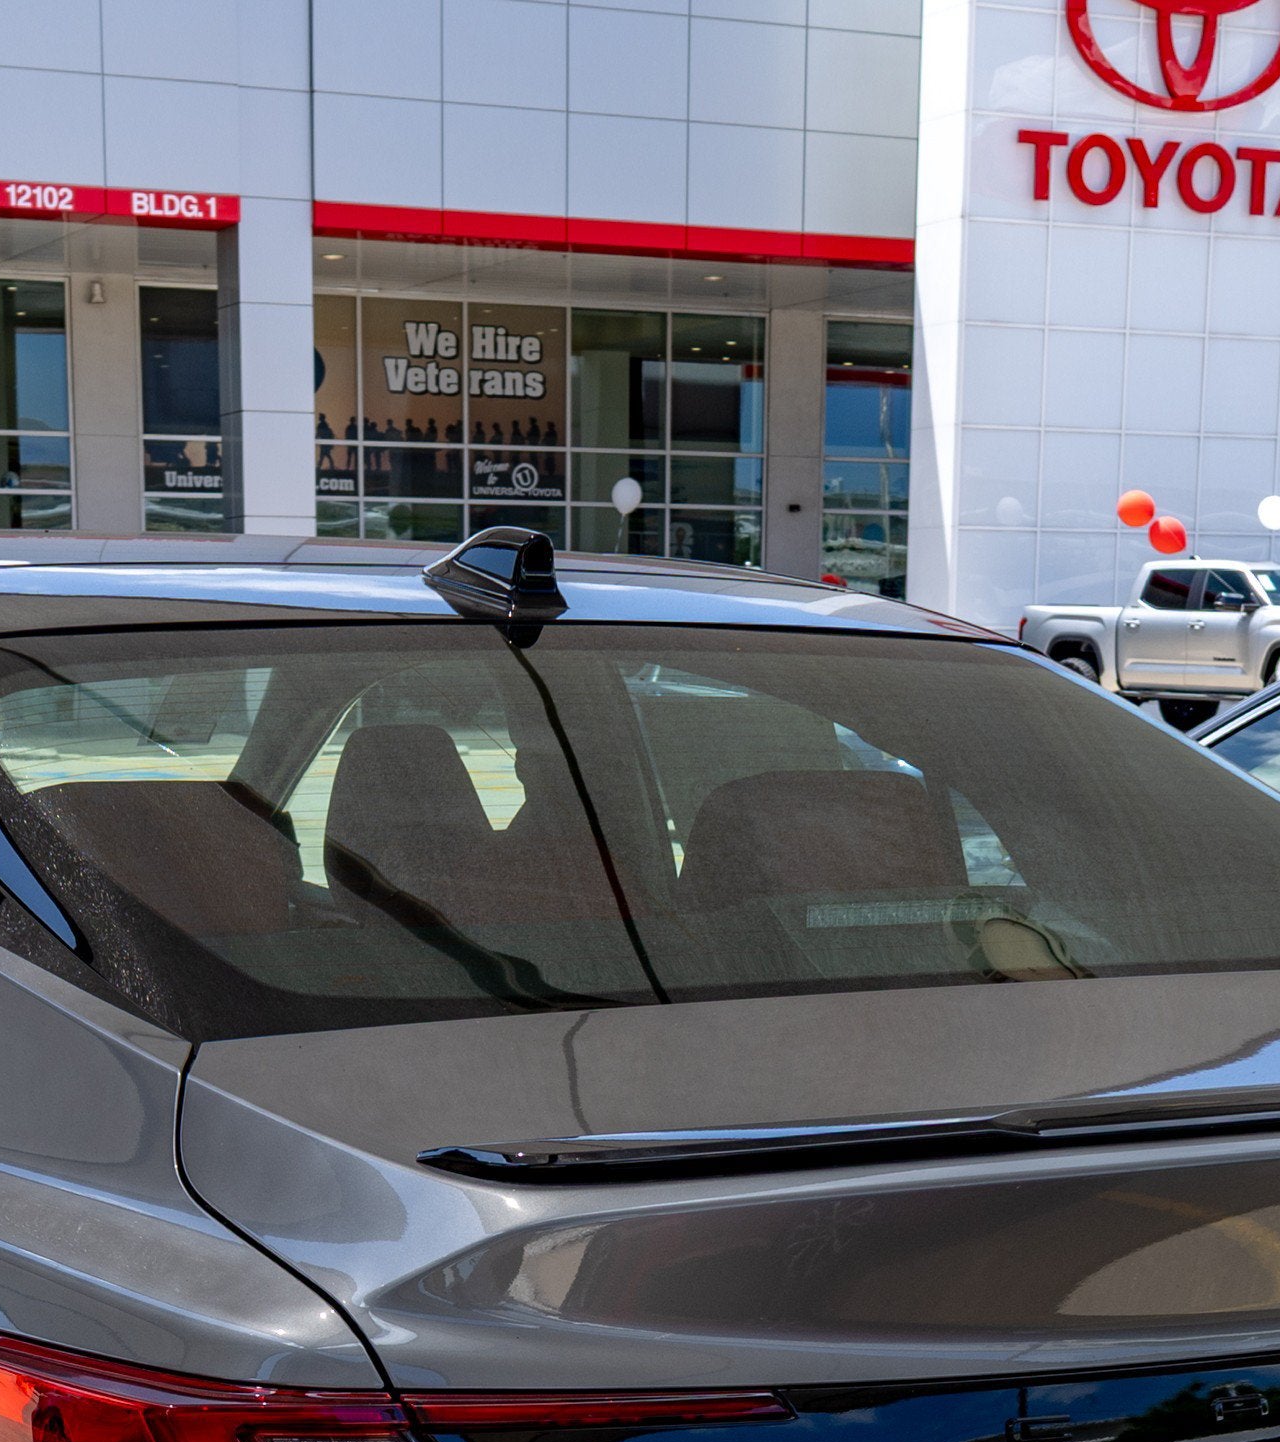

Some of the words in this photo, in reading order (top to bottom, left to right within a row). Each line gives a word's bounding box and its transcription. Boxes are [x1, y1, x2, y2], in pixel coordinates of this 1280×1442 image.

[6, 184, 73, 210] 12102
[404, 321, 459, 359] We
[471, 325, 543, 363] Hire
[164, 471, 223, 488] Univer
[472, 486, 526, 496] UNIVERSAL
[527, 487, 563, 497] TOYOTA
